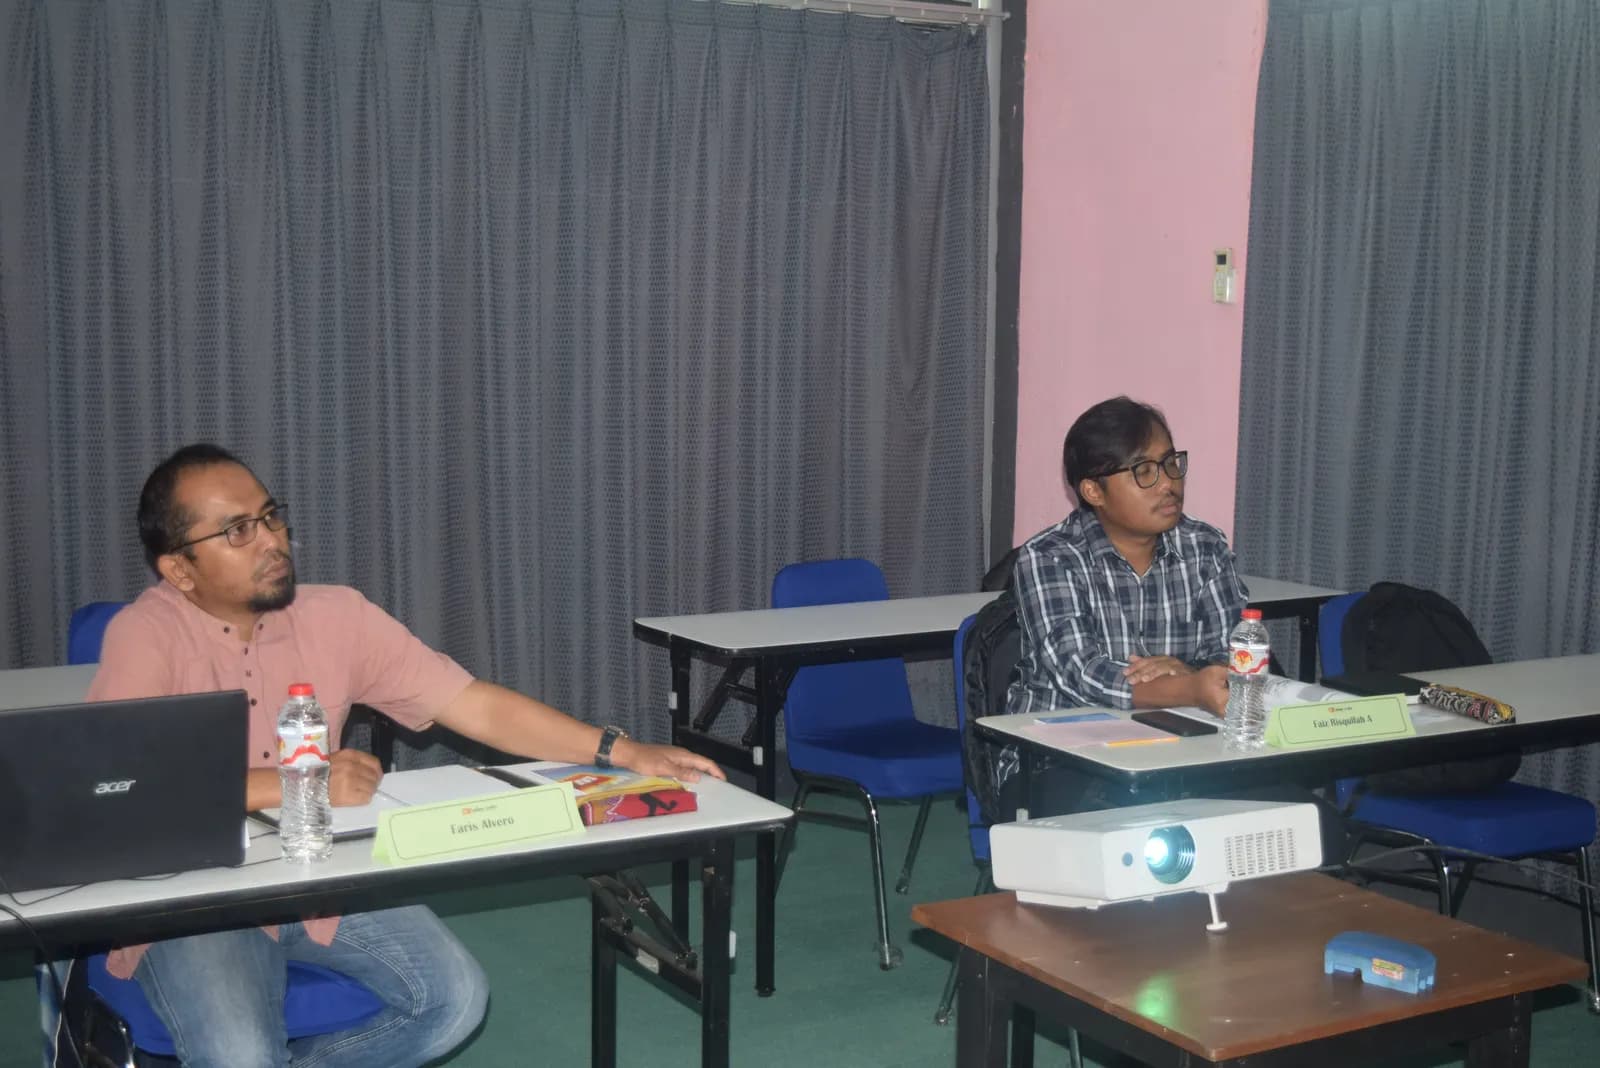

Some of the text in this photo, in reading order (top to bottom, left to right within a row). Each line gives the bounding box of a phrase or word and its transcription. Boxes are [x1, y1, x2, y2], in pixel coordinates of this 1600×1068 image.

[95, 780, 136, 793] acer
[450, 816, 514, 834] Faris Alvero
